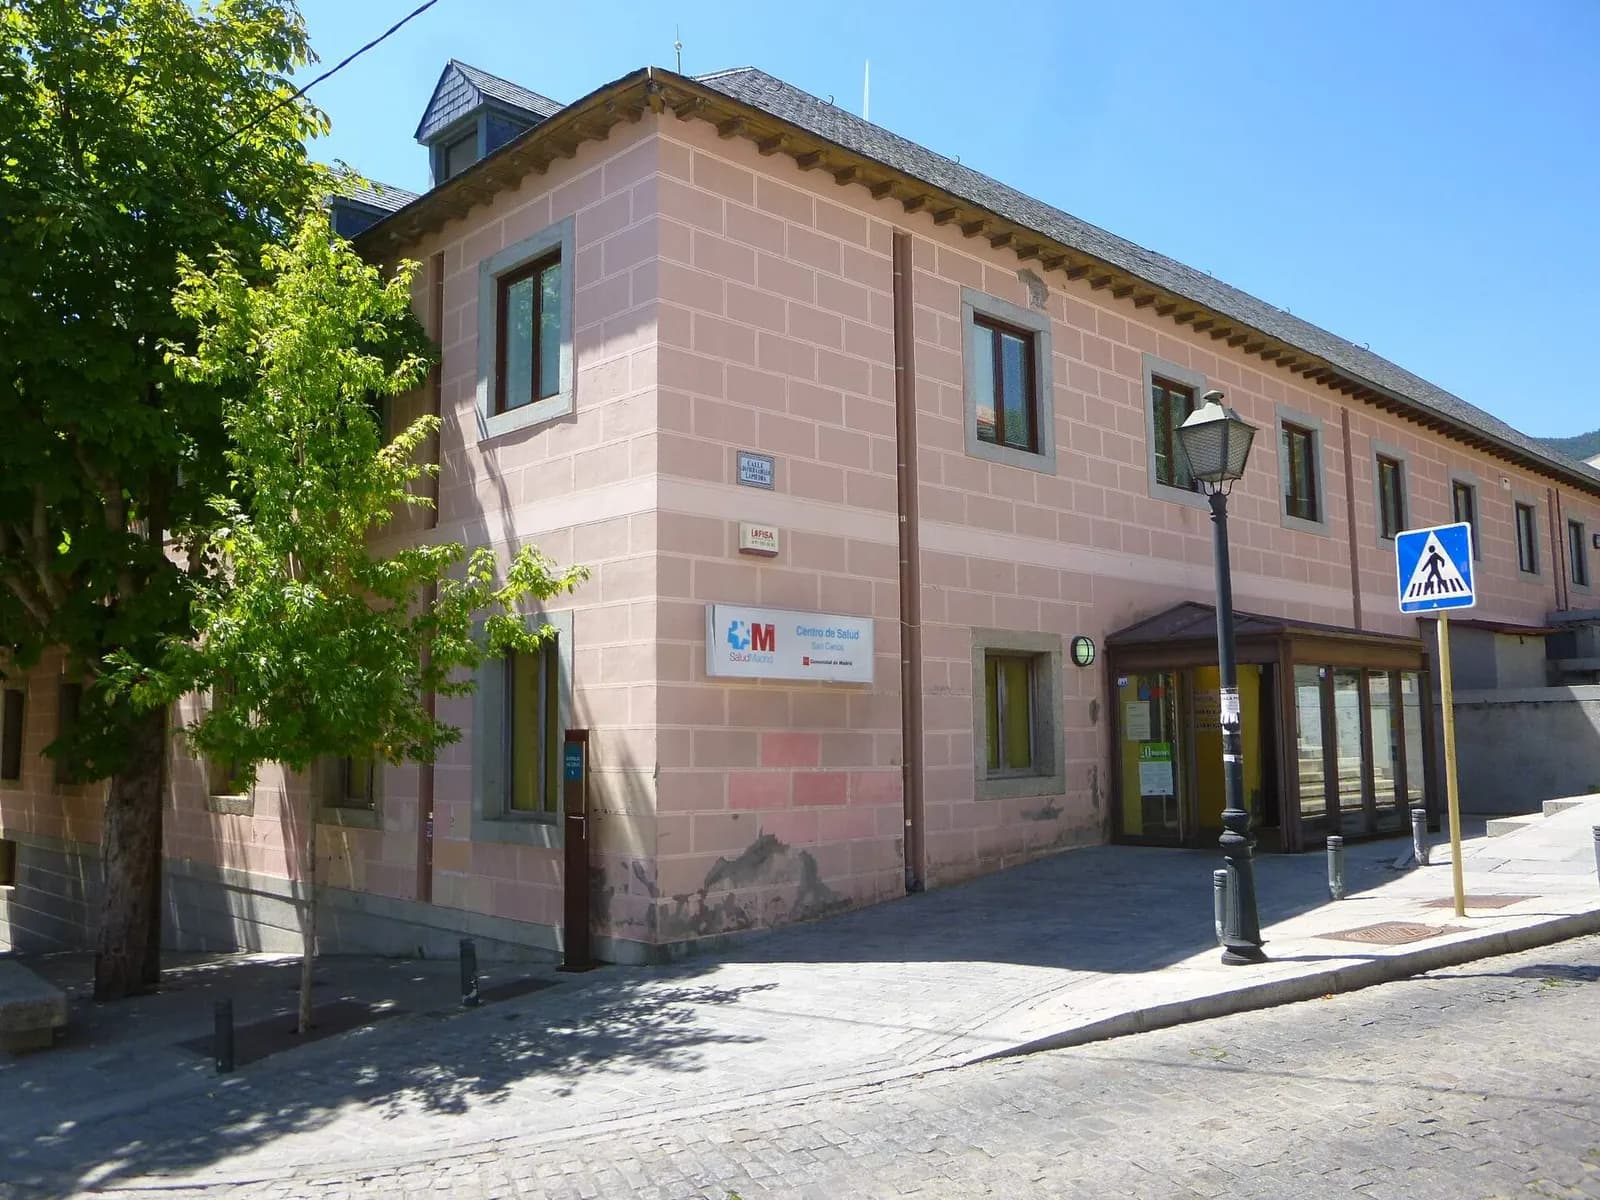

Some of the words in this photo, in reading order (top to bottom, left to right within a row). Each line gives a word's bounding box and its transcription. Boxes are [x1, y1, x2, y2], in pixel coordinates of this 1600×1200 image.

[751, 622, 775, 651] M
[796, 625, 824, 637] Centro
[825, 628, 835, 638] de
[837, 629, 860, 640] Salud
